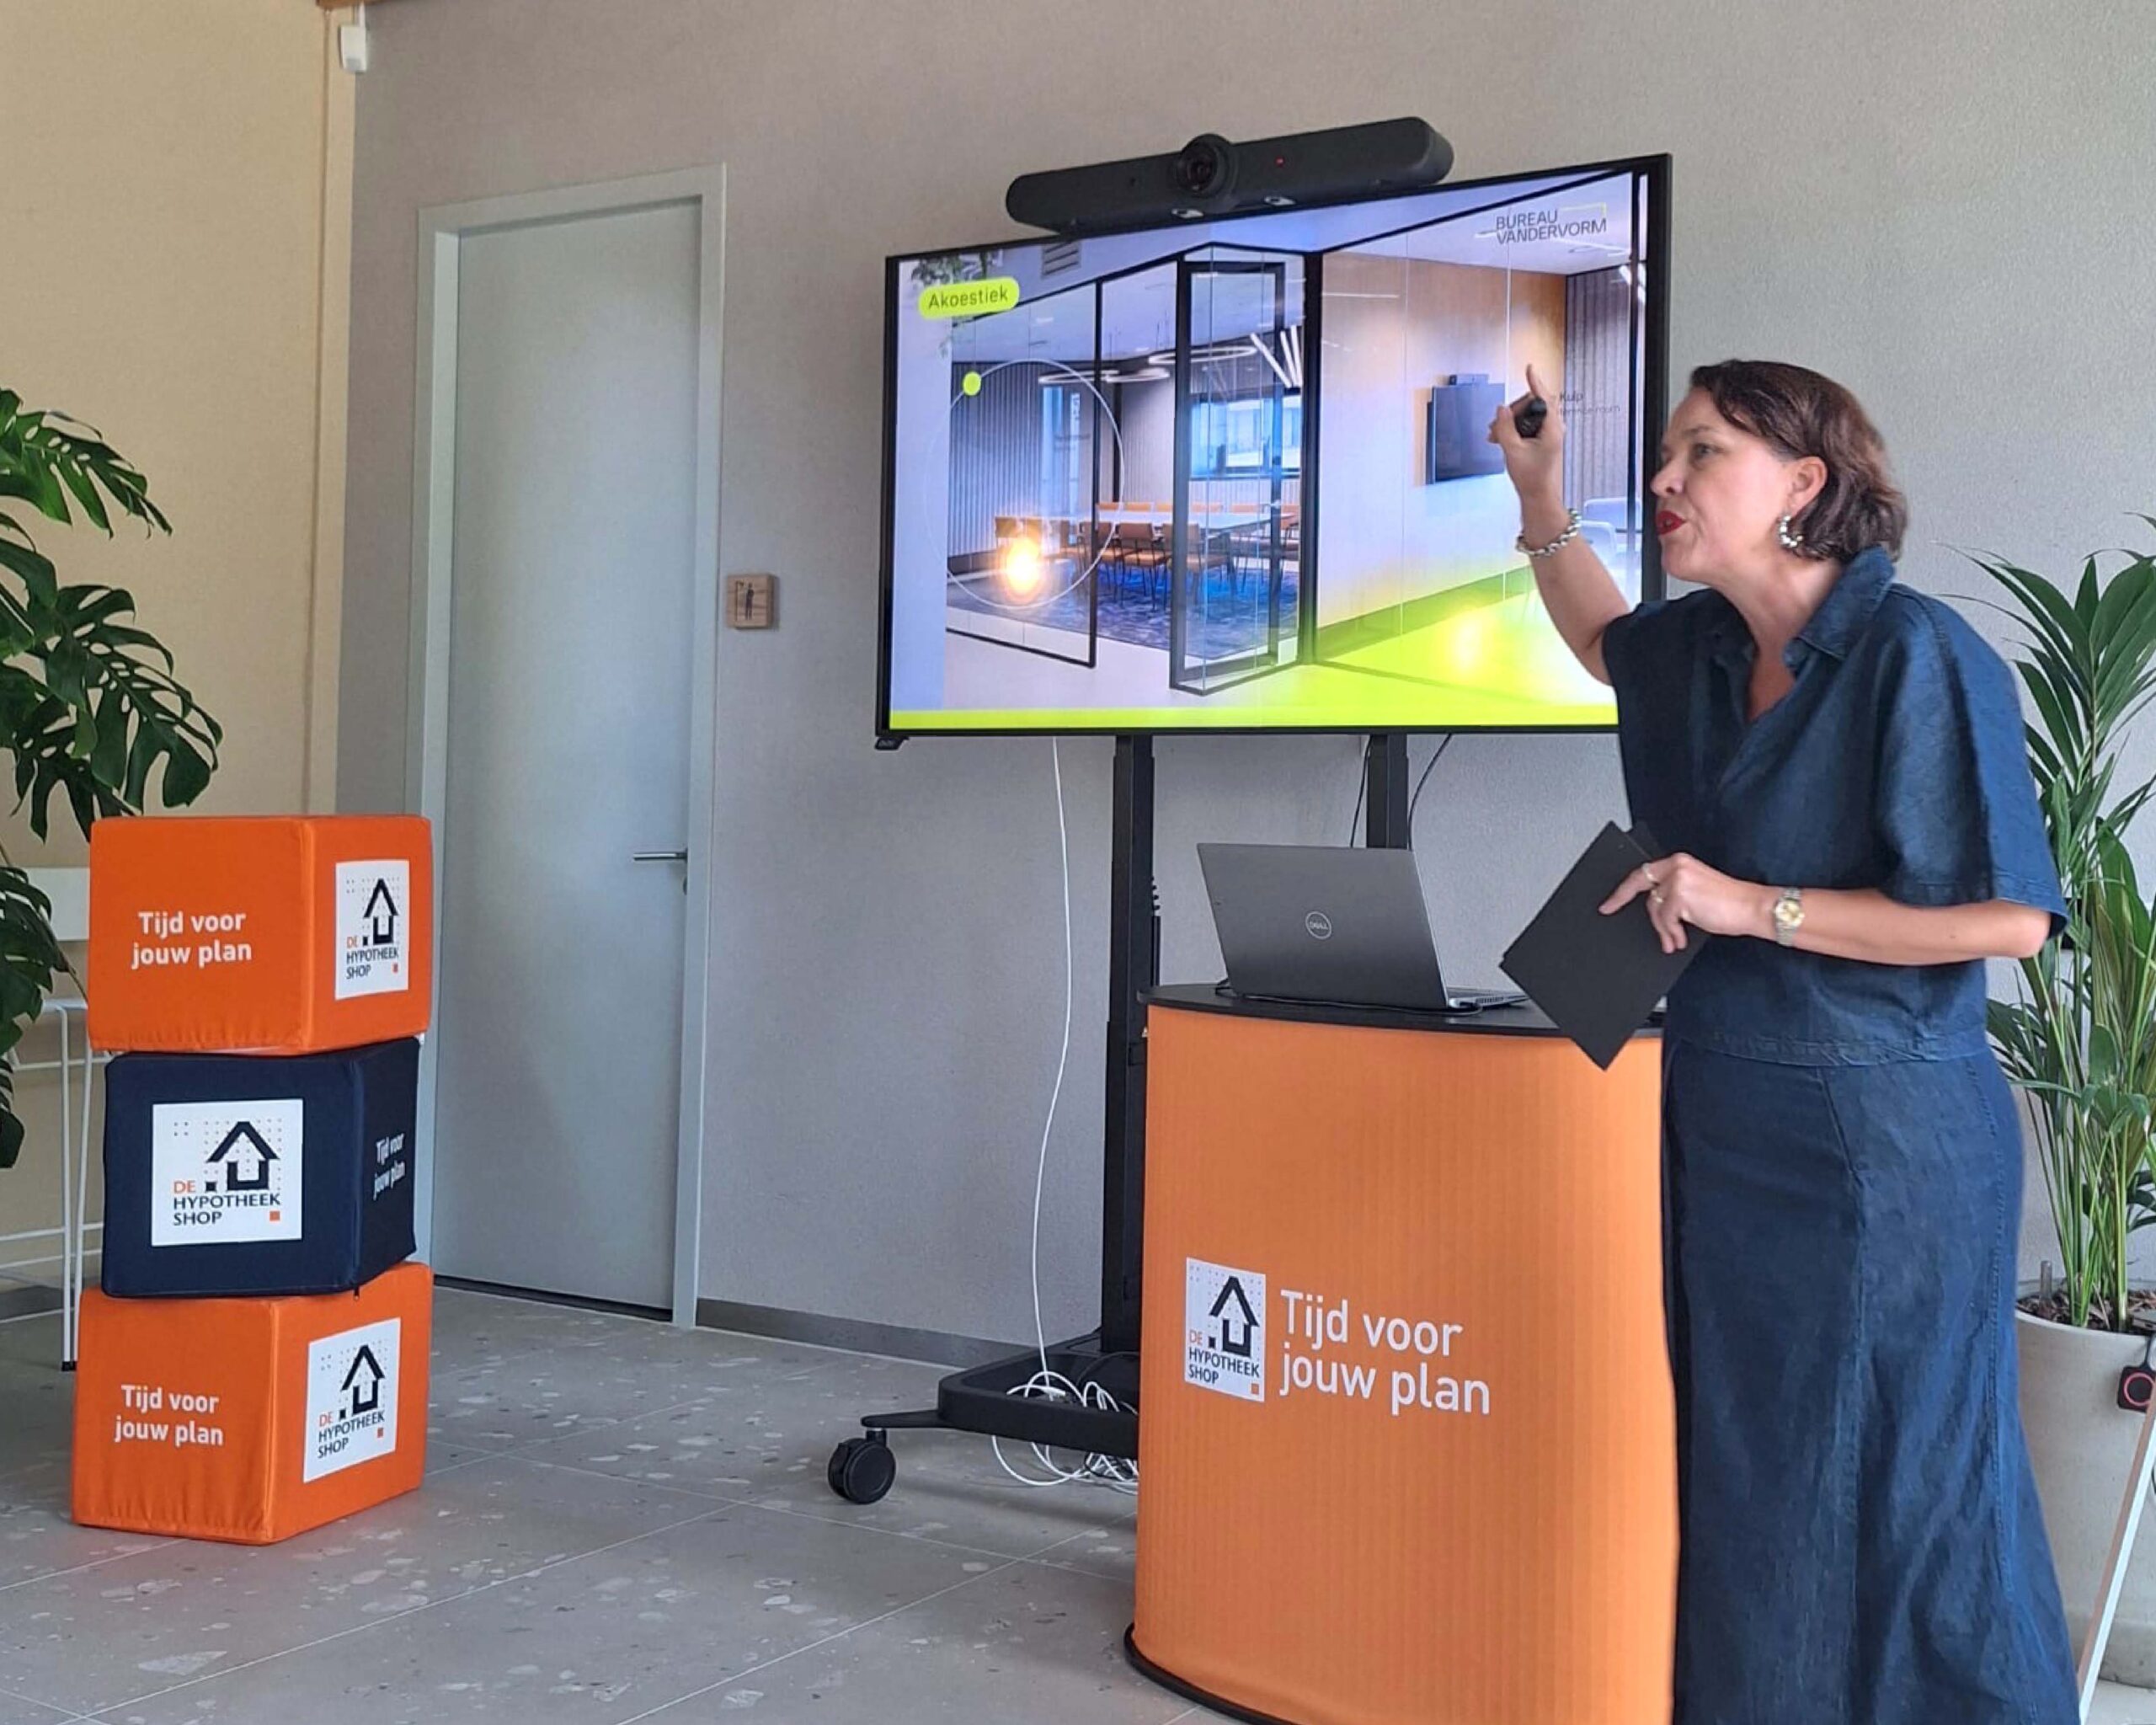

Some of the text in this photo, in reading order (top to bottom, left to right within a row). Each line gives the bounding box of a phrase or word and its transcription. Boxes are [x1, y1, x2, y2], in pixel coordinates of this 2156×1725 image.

[1496, 210, 1558, 230] BUREAU
[1497, 218, 1607, 244] VANDERVORM
[928, 285, 1009, 310] Akoestiek
[138, 911, 247, 940] Tijd voor
[346, 936, 359, 948] DE
[131, 940, 253, 970] jouw plan
[346, 947, 399, 964] HYPOTHEEK
[346, 964, 371, 980] SHOP
[173, 1180, 196, 1194] DE
[173, 1193, 281, 1210] HYPOTHEEK
[173, 1210, 222, 1226] SHOP
[1280, 1289, 1464, 1357] Tijd voor
[1189, 1329, 1203, 1347] DE
[1188, 1347, 1260, 1378] HYPOTHEEK
[1188, 1364, 1219, 1386] SHOP
[1279, 1342, 1491, 1416] jouw plan
[120, 1385, 220, 1414] Tijd voor
[318, 1411, 334, 1427] DE
[318, 1410, 386, 1443] HYPOTHEEK
[115, 1415, 224, 1447] jouw plan
[318, 1437, 350, 1459] SHOP
